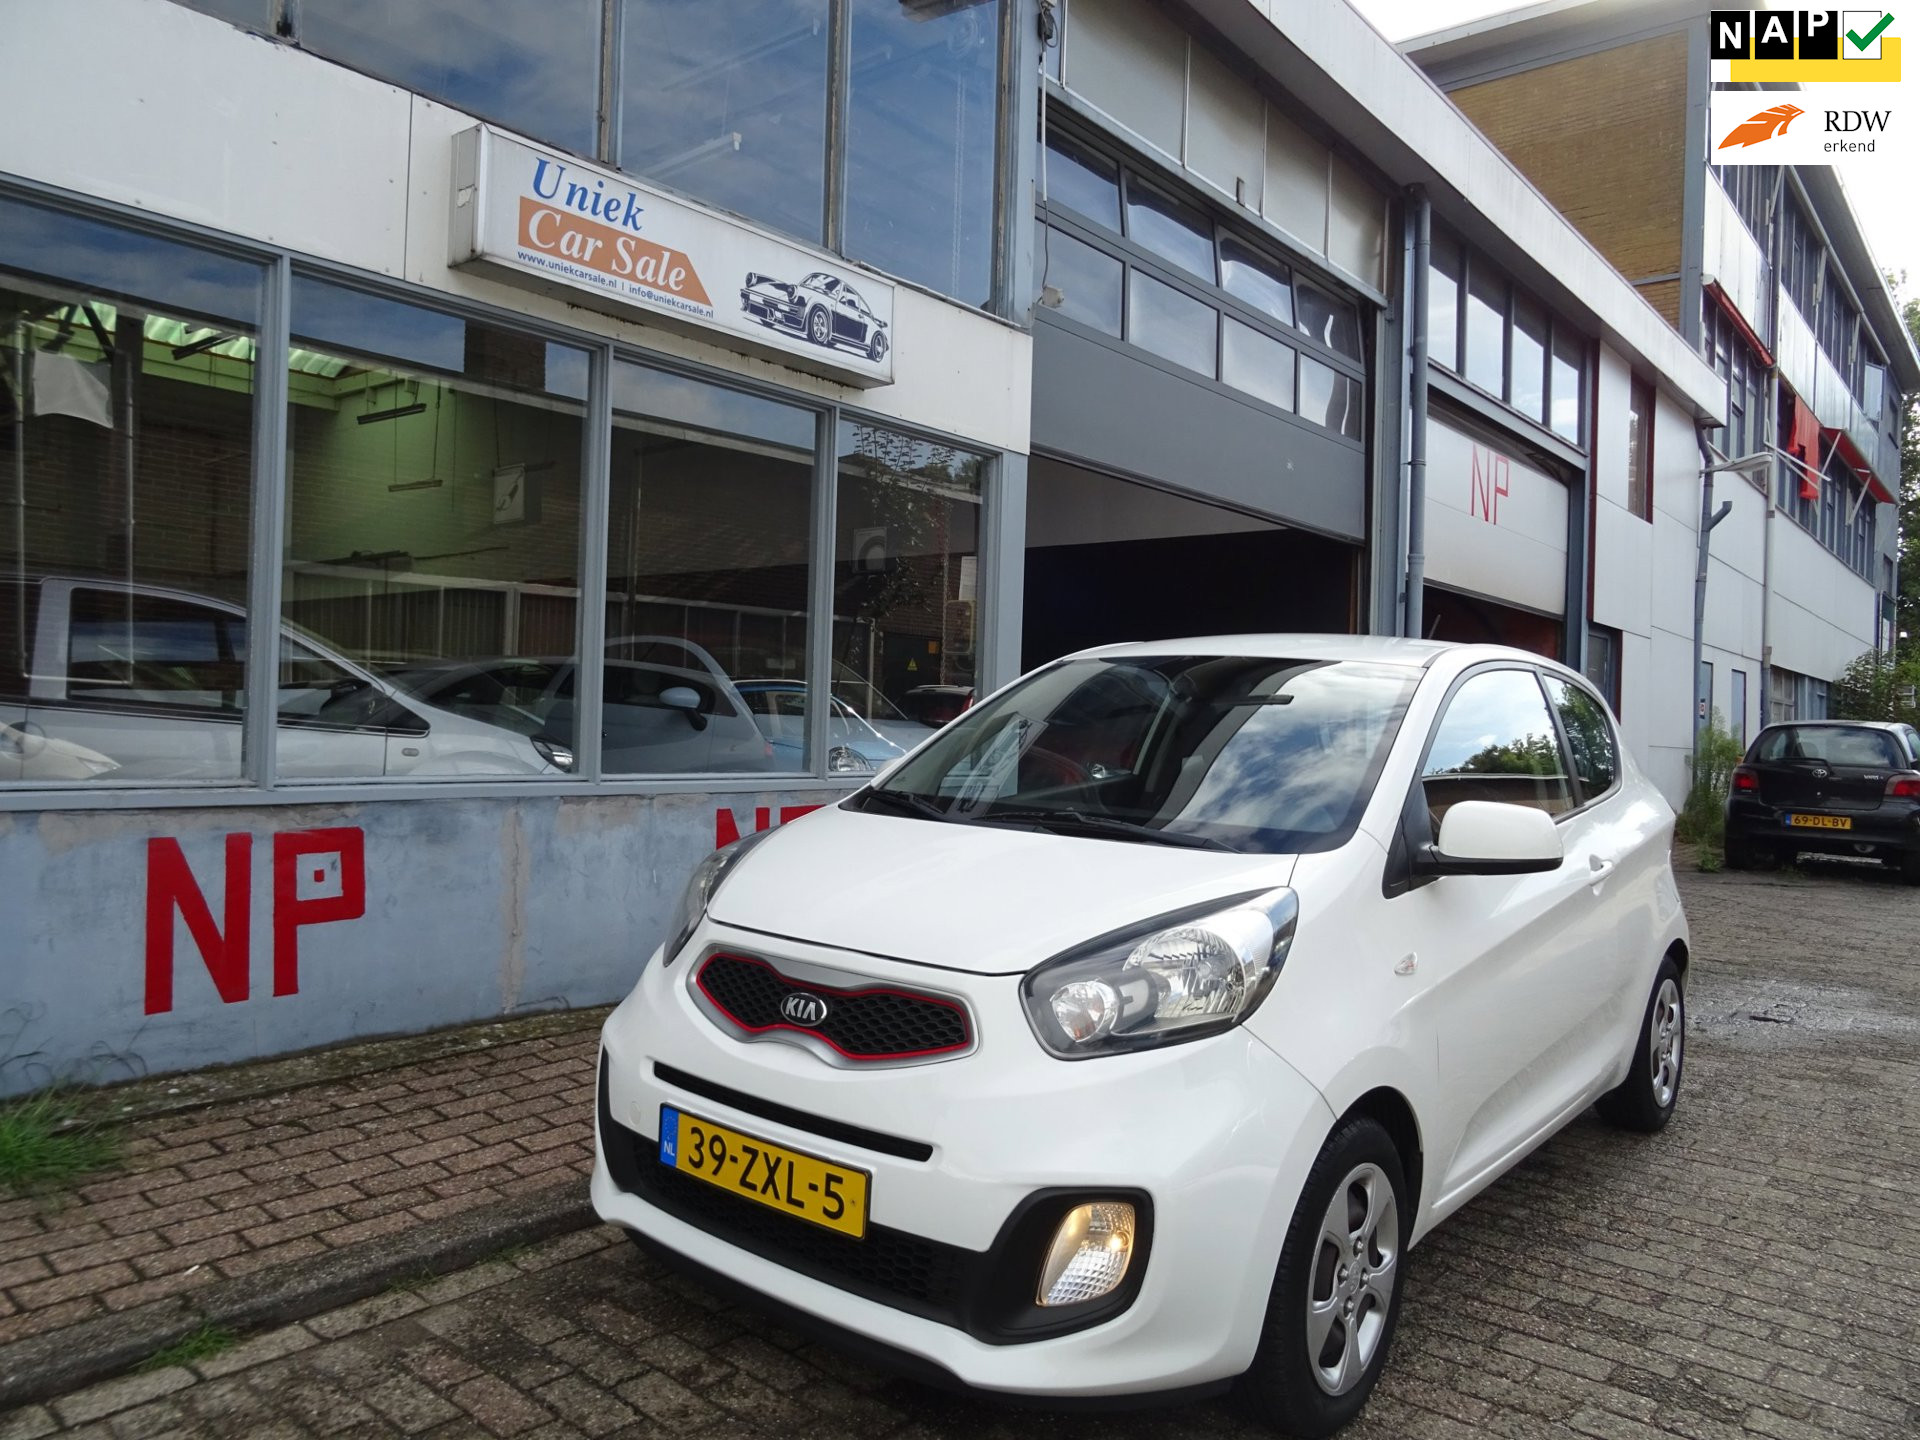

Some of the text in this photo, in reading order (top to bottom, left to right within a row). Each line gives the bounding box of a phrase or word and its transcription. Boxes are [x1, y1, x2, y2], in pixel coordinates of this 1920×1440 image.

[532, 157, 645, 232] Uniek
[517, 250, 617, 289] www.uniekcarsale.nl
[629, 284, 714, 319] info@uniekcarsale.nl
[528, 208, 686, 292] Car Sale
[1471, 442, 1509, 525] NP
[1794, 815, 1848, 827] 69-DL-BV
[144, 826, 366, 1016] NP
[784, 997, 817, 1022] KIA
[663, 1140, 676, 1157] NL
[688, 1126, 845, 1221] 39-ZXL-5
